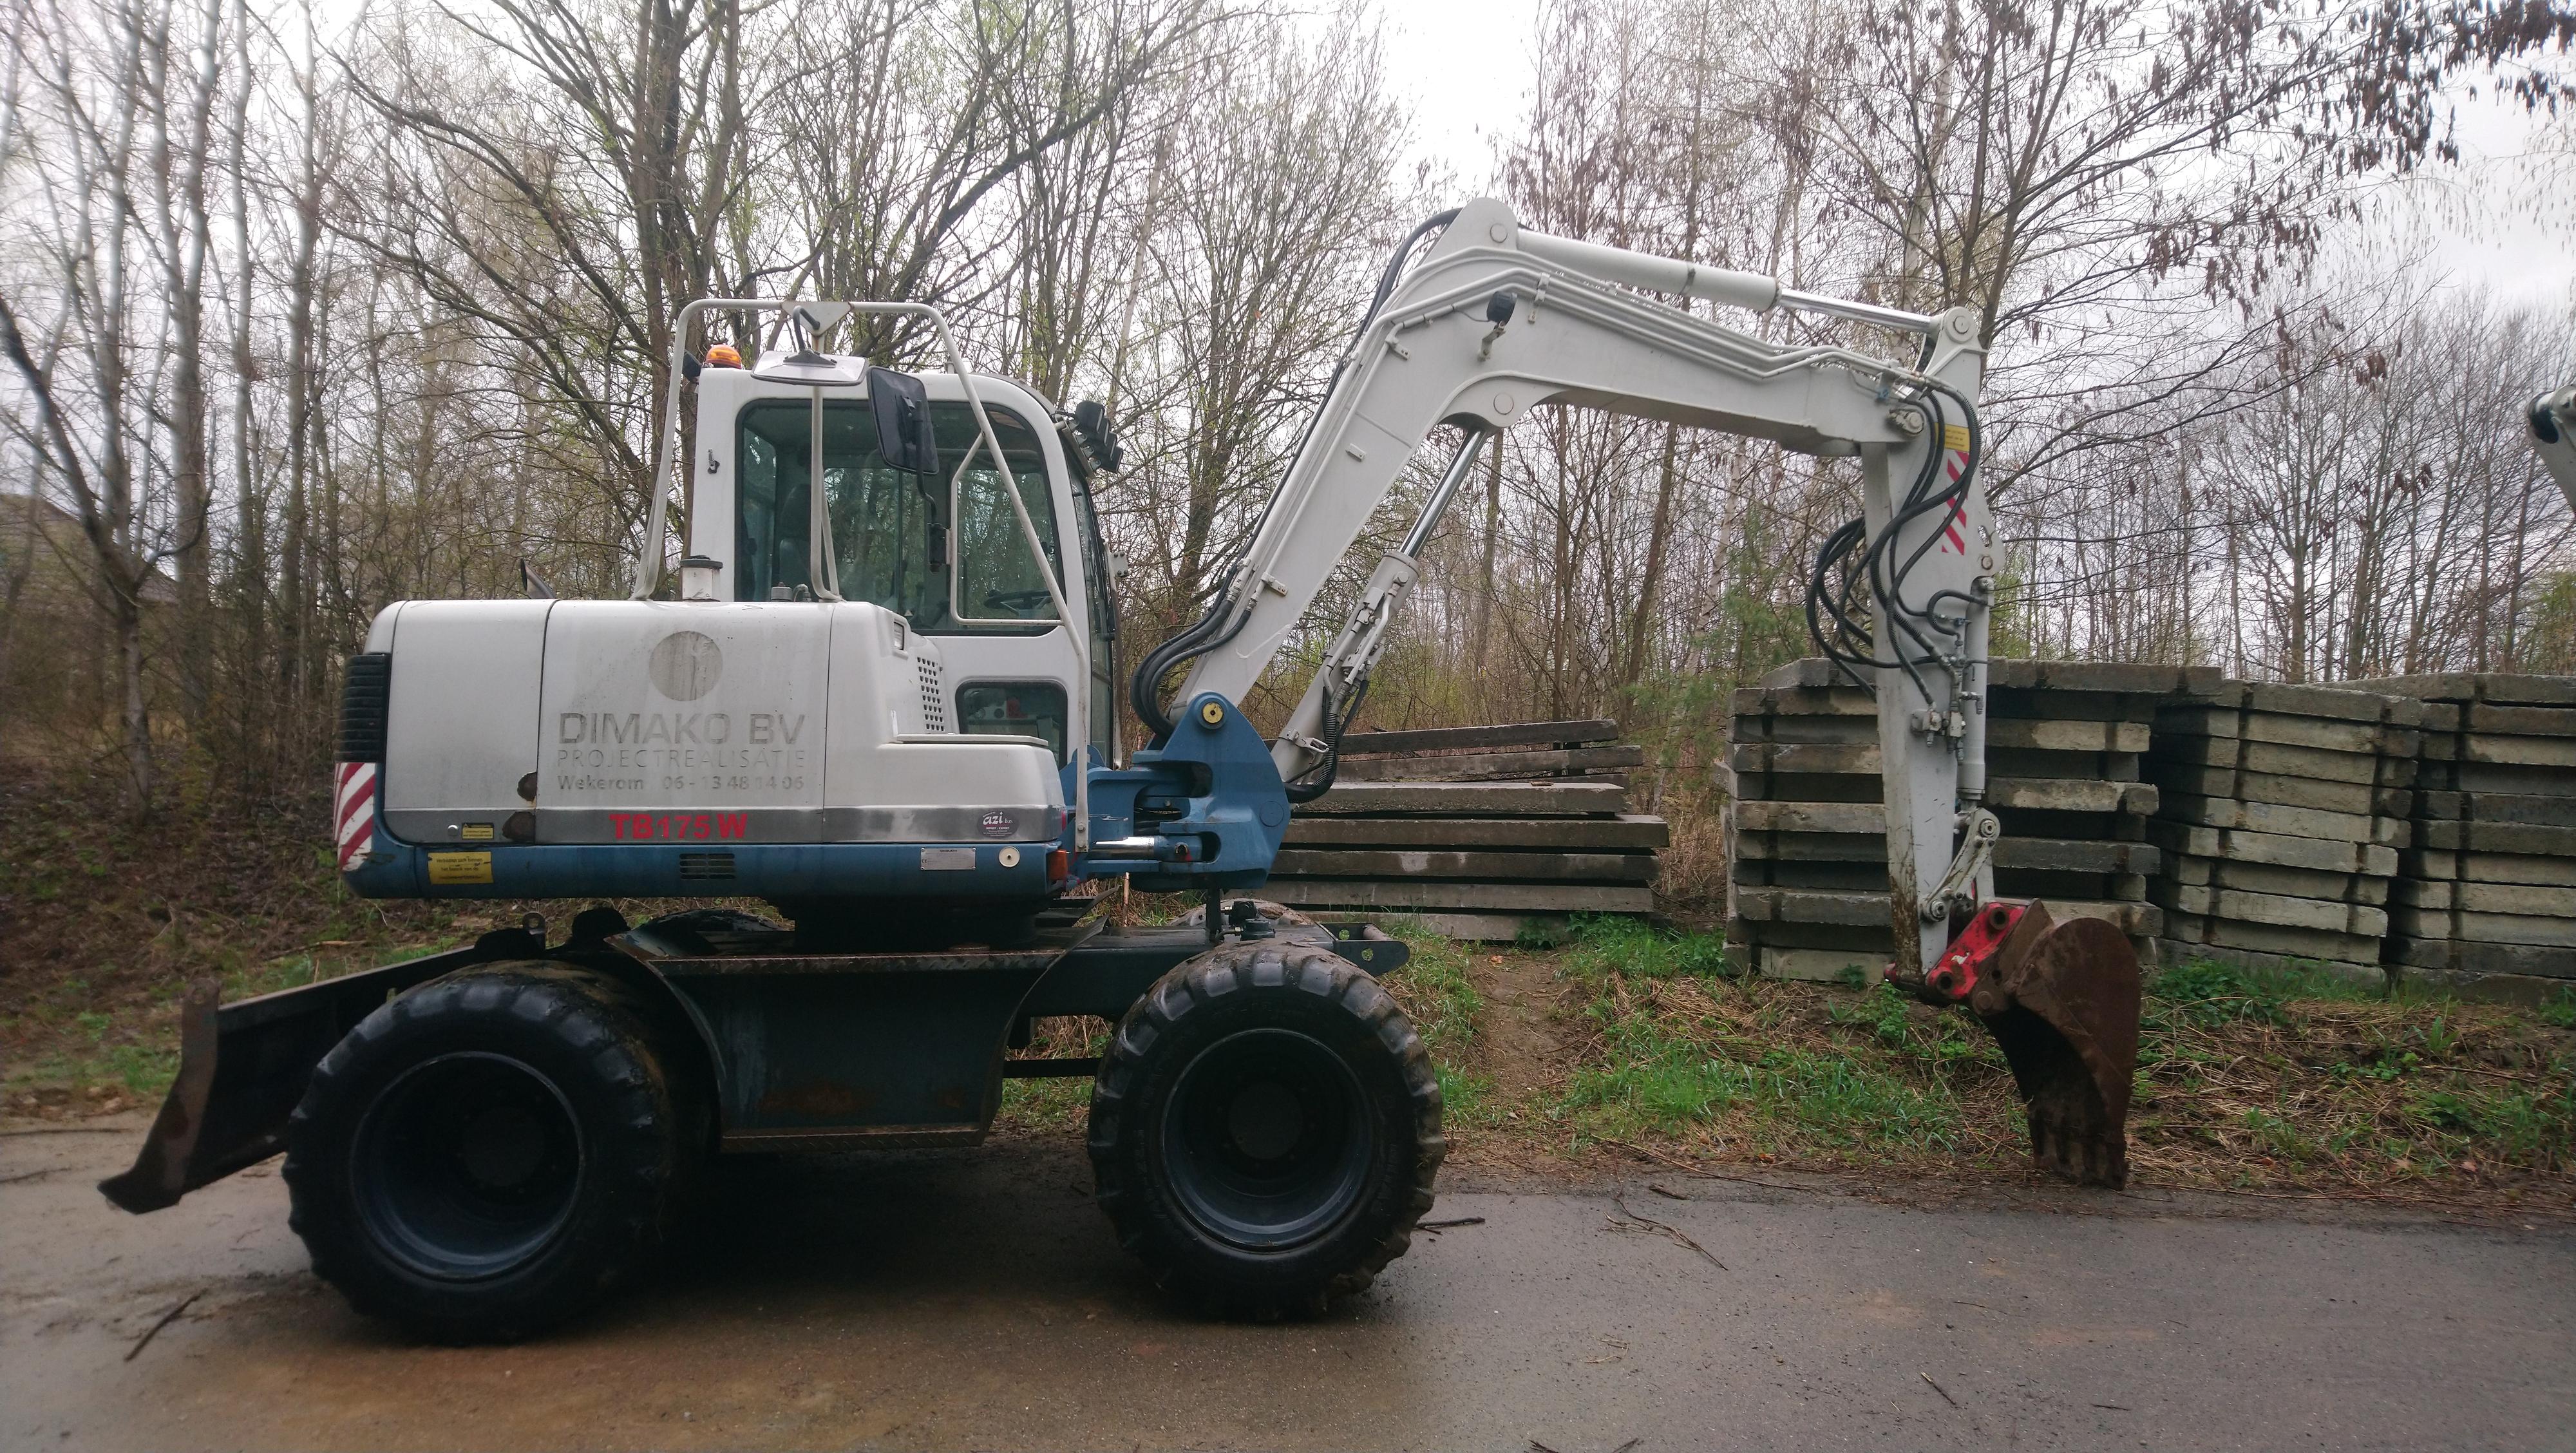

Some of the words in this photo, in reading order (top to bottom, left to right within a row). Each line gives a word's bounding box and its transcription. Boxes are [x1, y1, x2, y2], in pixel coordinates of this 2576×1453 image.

[558, 712, 731, 744] DIMAKO
[749, 713, 806, 745] BV
[557, 749, 805, 768] PROJECTREALISATIE
[556, 774, 644, 790] Wekerom
[663, 775, 685, 790] 06
[727, 775, 750, 790] 48
[782, 775, 804, 790] 06
[983, 812, 1003, 825] azi
